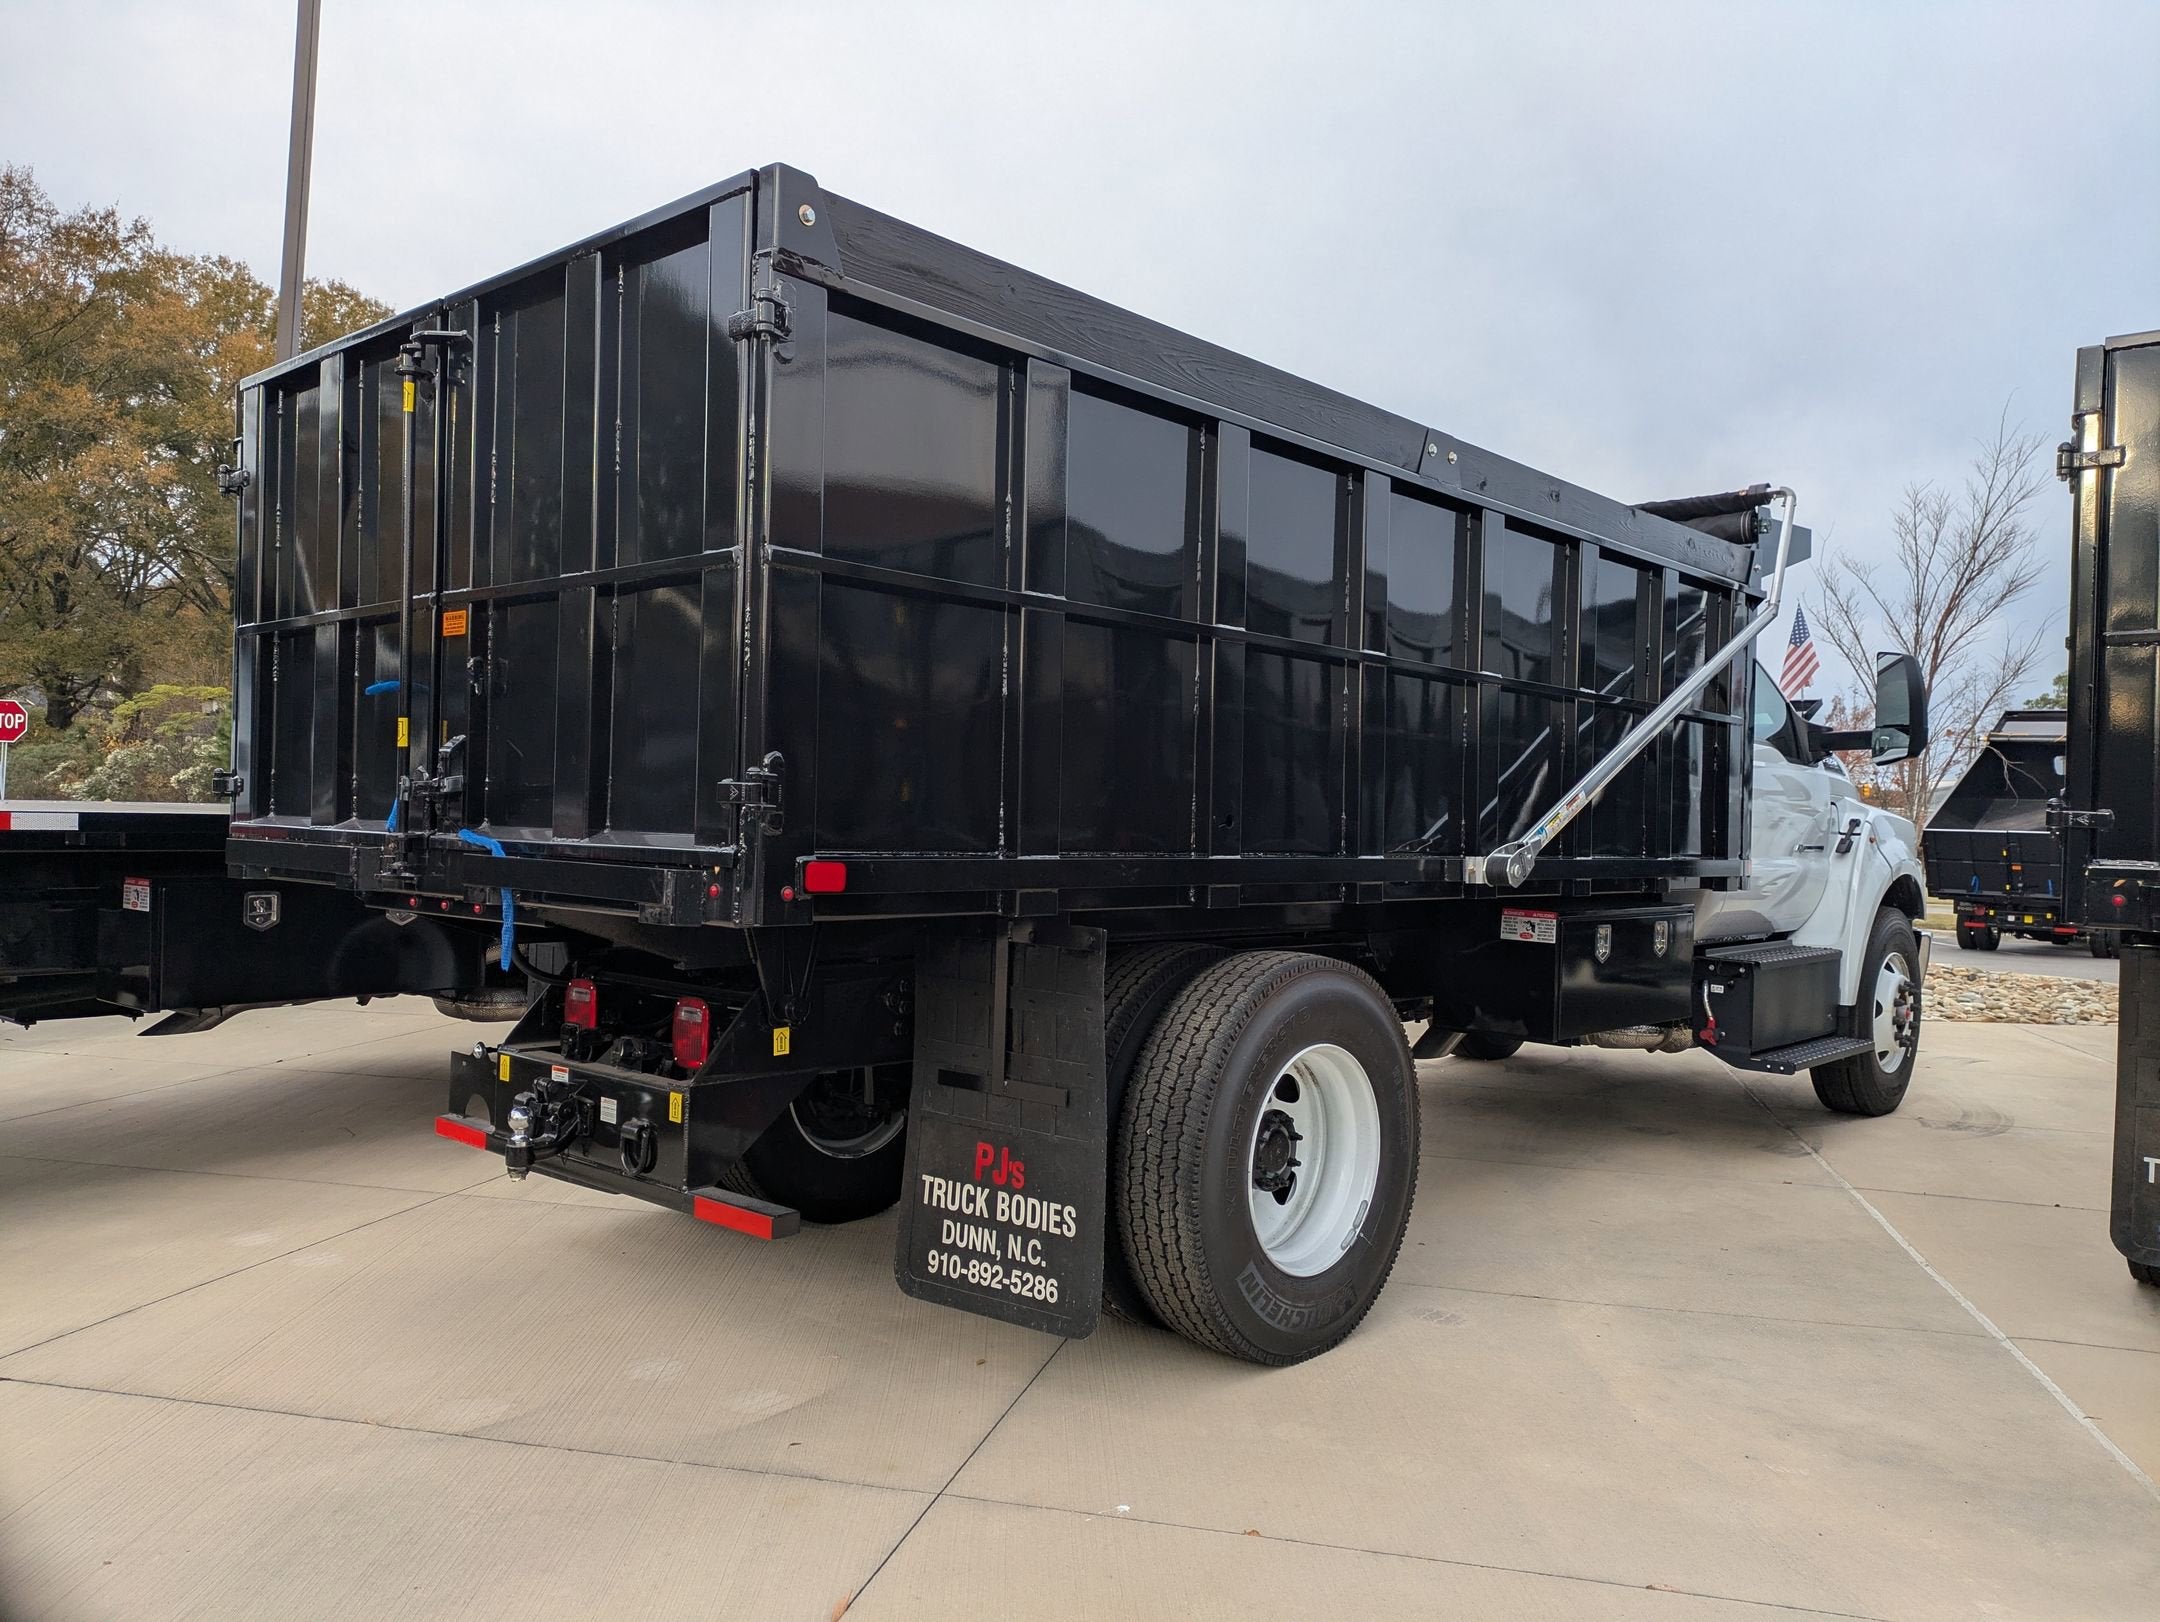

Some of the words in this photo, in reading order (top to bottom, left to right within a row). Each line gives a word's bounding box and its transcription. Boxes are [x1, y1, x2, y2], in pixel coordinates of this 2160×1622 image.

[0, 713, 25, 729] TOP
[921, 1173, 990, 1219] TRUCK
[996, 1190, 1077, 1239] BODIES
[941, 1218, 1001, 1261] DUNN,
[1007, 1233, 1047, 1268] N.C.
[927, 1249, 1059, 1304] 910-892-5286
